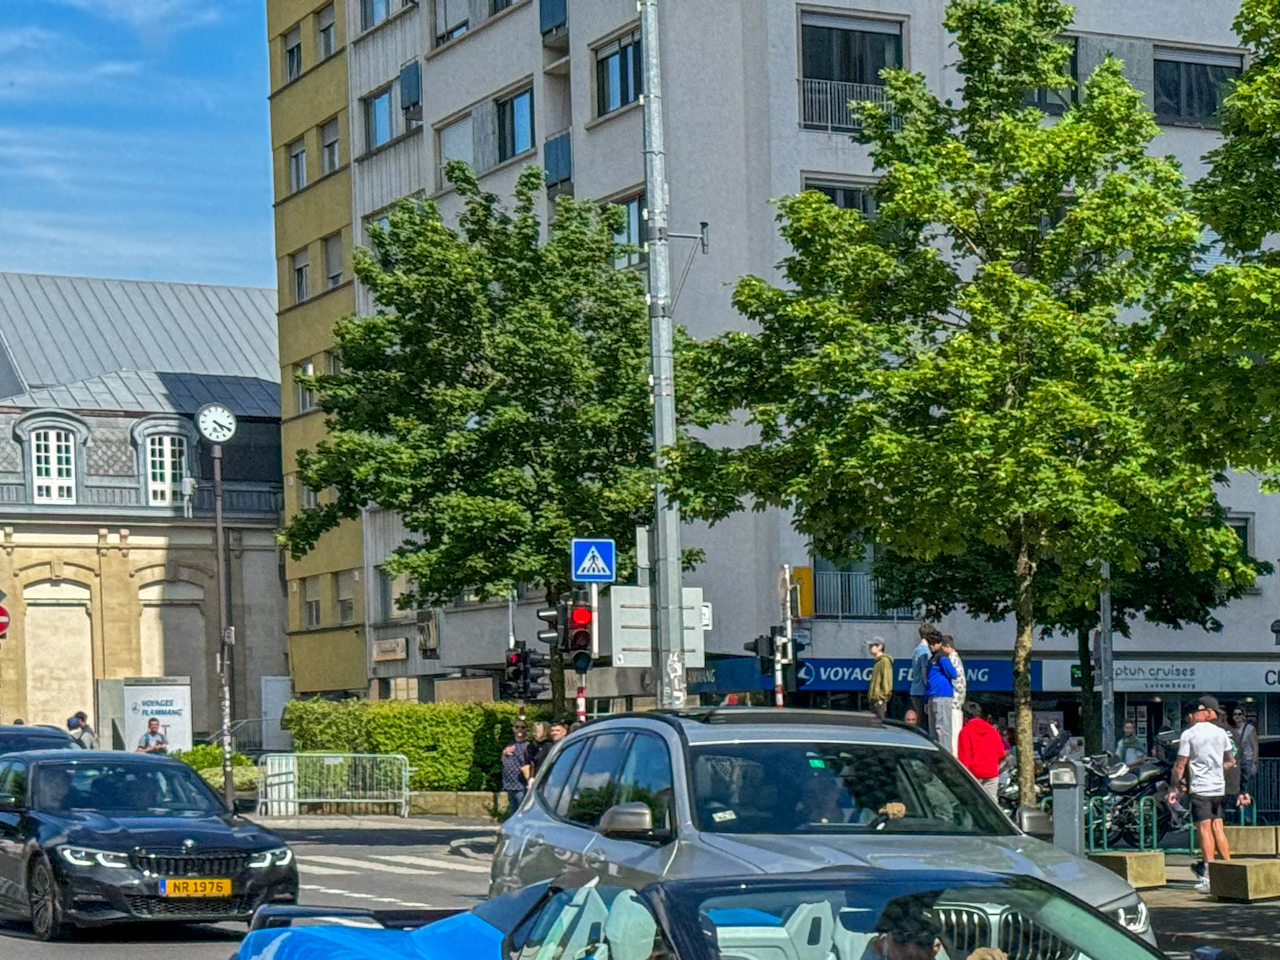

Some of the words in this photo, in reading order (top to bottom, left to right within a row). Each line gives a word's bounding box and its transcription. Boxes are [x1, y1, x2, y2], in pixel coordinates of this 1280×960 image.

[820, 666, 874, 681] VOYAG
[1113, 665, 1145, 678] ptun
[1149, 665, 1196, 677] cruises
[142, 699, 174, 707] VOYAGES
[173, 882, 189, 893] NR
[193, 882, 224, 893] 1976
